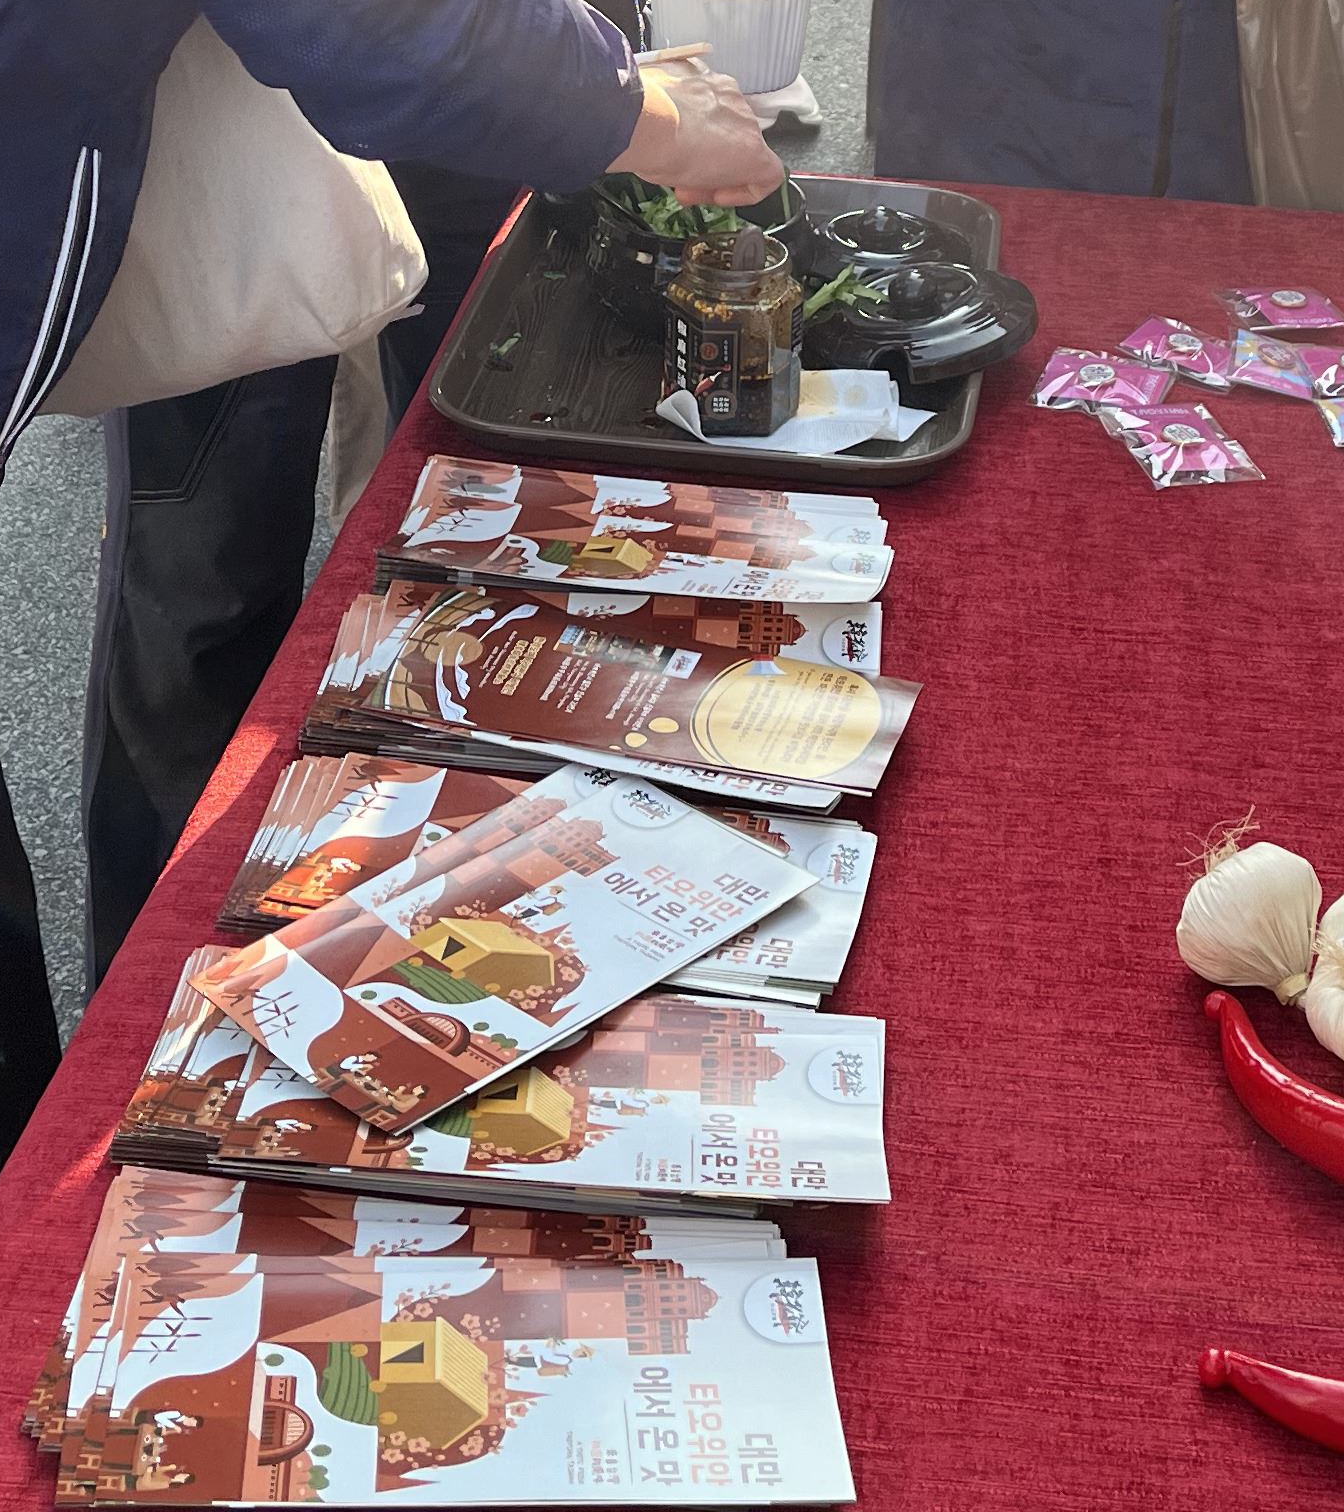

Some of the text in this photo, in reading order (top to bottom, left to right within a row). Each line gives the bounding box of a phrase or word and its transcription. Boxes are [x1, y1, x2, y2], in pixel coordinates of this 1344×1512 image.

[603, 872, 718, 938] 에서 온 맛
[642, 864, 745, 922] 타오위안
[713, 872, 770, 906] 대만
[756, 937, 793, 969] 대만
[702, 1113, 738, 1186] 에서 온 맛
[746, 1128, 782, 1189] 타오위안
[790, 1160, 829, 1189] 대만
[633, 1366, 683, 1486] 에서 온 맛
[683, 1384, 733, 1486] 타오위안
[737, 1433, 784, 1486] 대만
